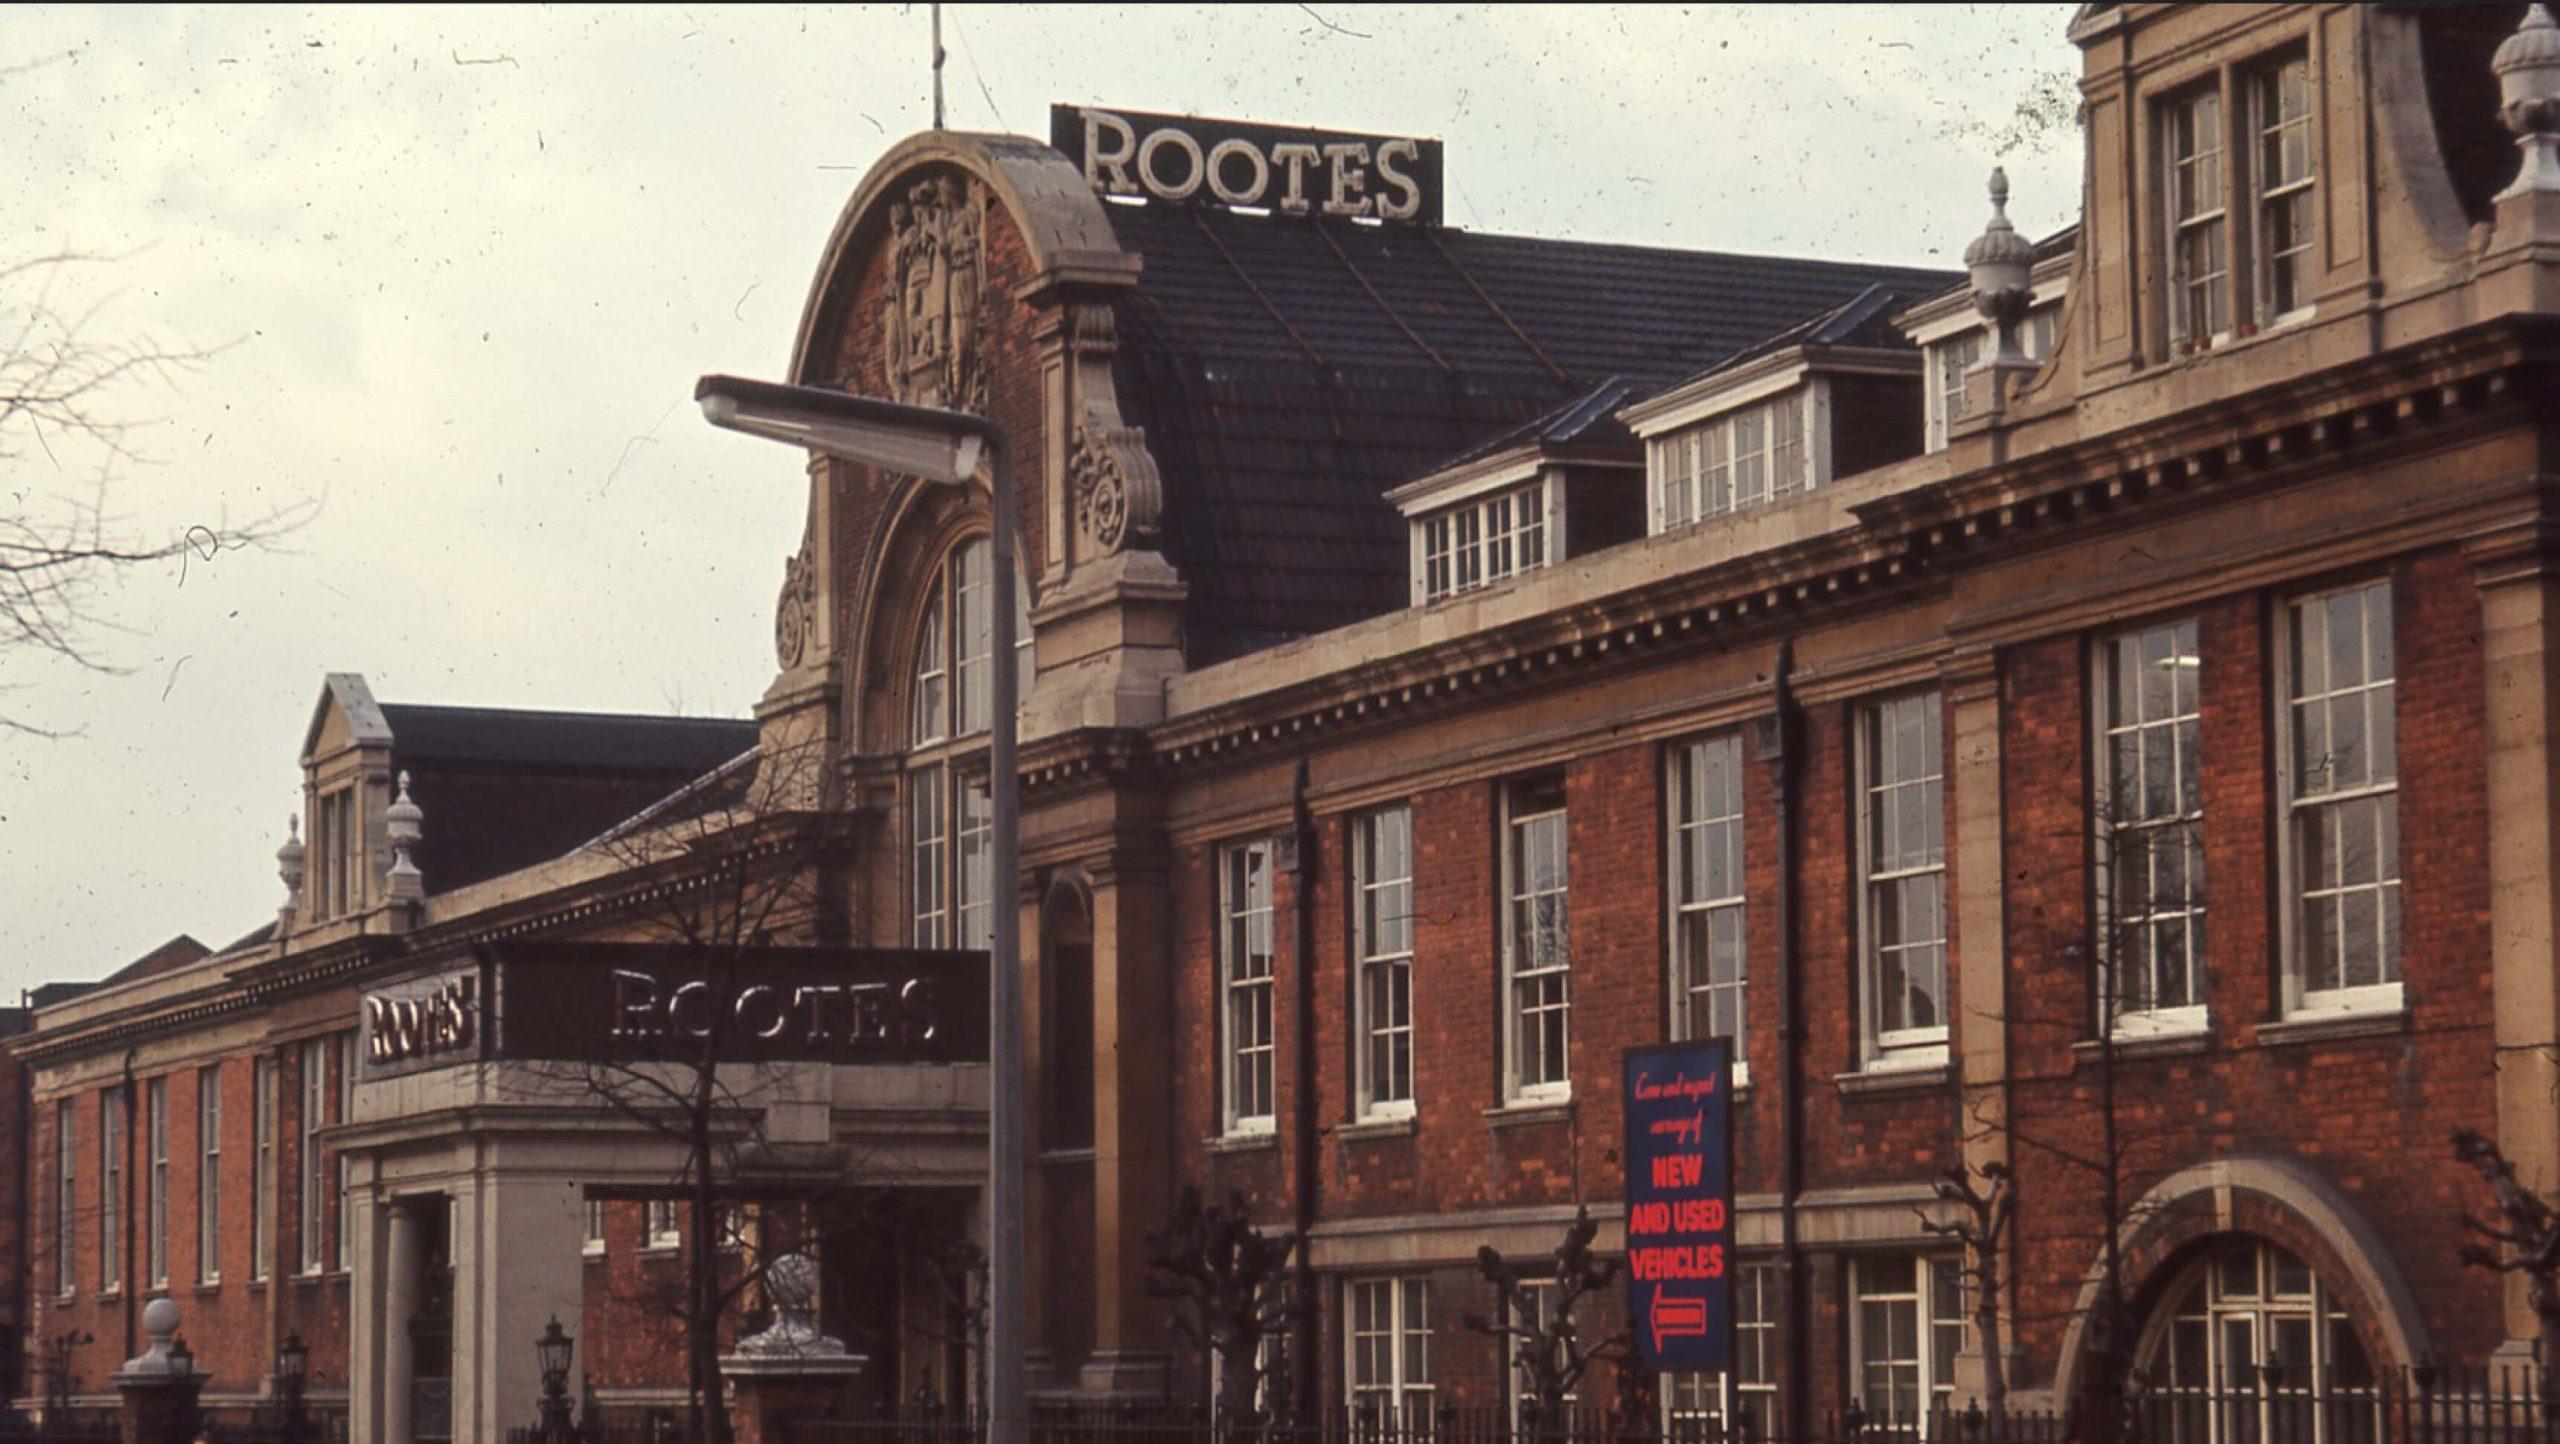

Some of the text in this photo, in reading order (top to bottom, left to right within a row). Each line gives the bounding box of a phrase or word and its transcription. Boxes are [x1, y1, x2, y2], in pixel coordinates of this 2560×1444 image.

[1079, 107, 1421, 220] ROOTES
[610, 968, 938, 1044] ROOTES
[1652, 1154, 1703, 1188] NEW
[1630, 1199, 1726, 1235] AND USED
[1630, 1245, 1724, 1280] VEHICLES
